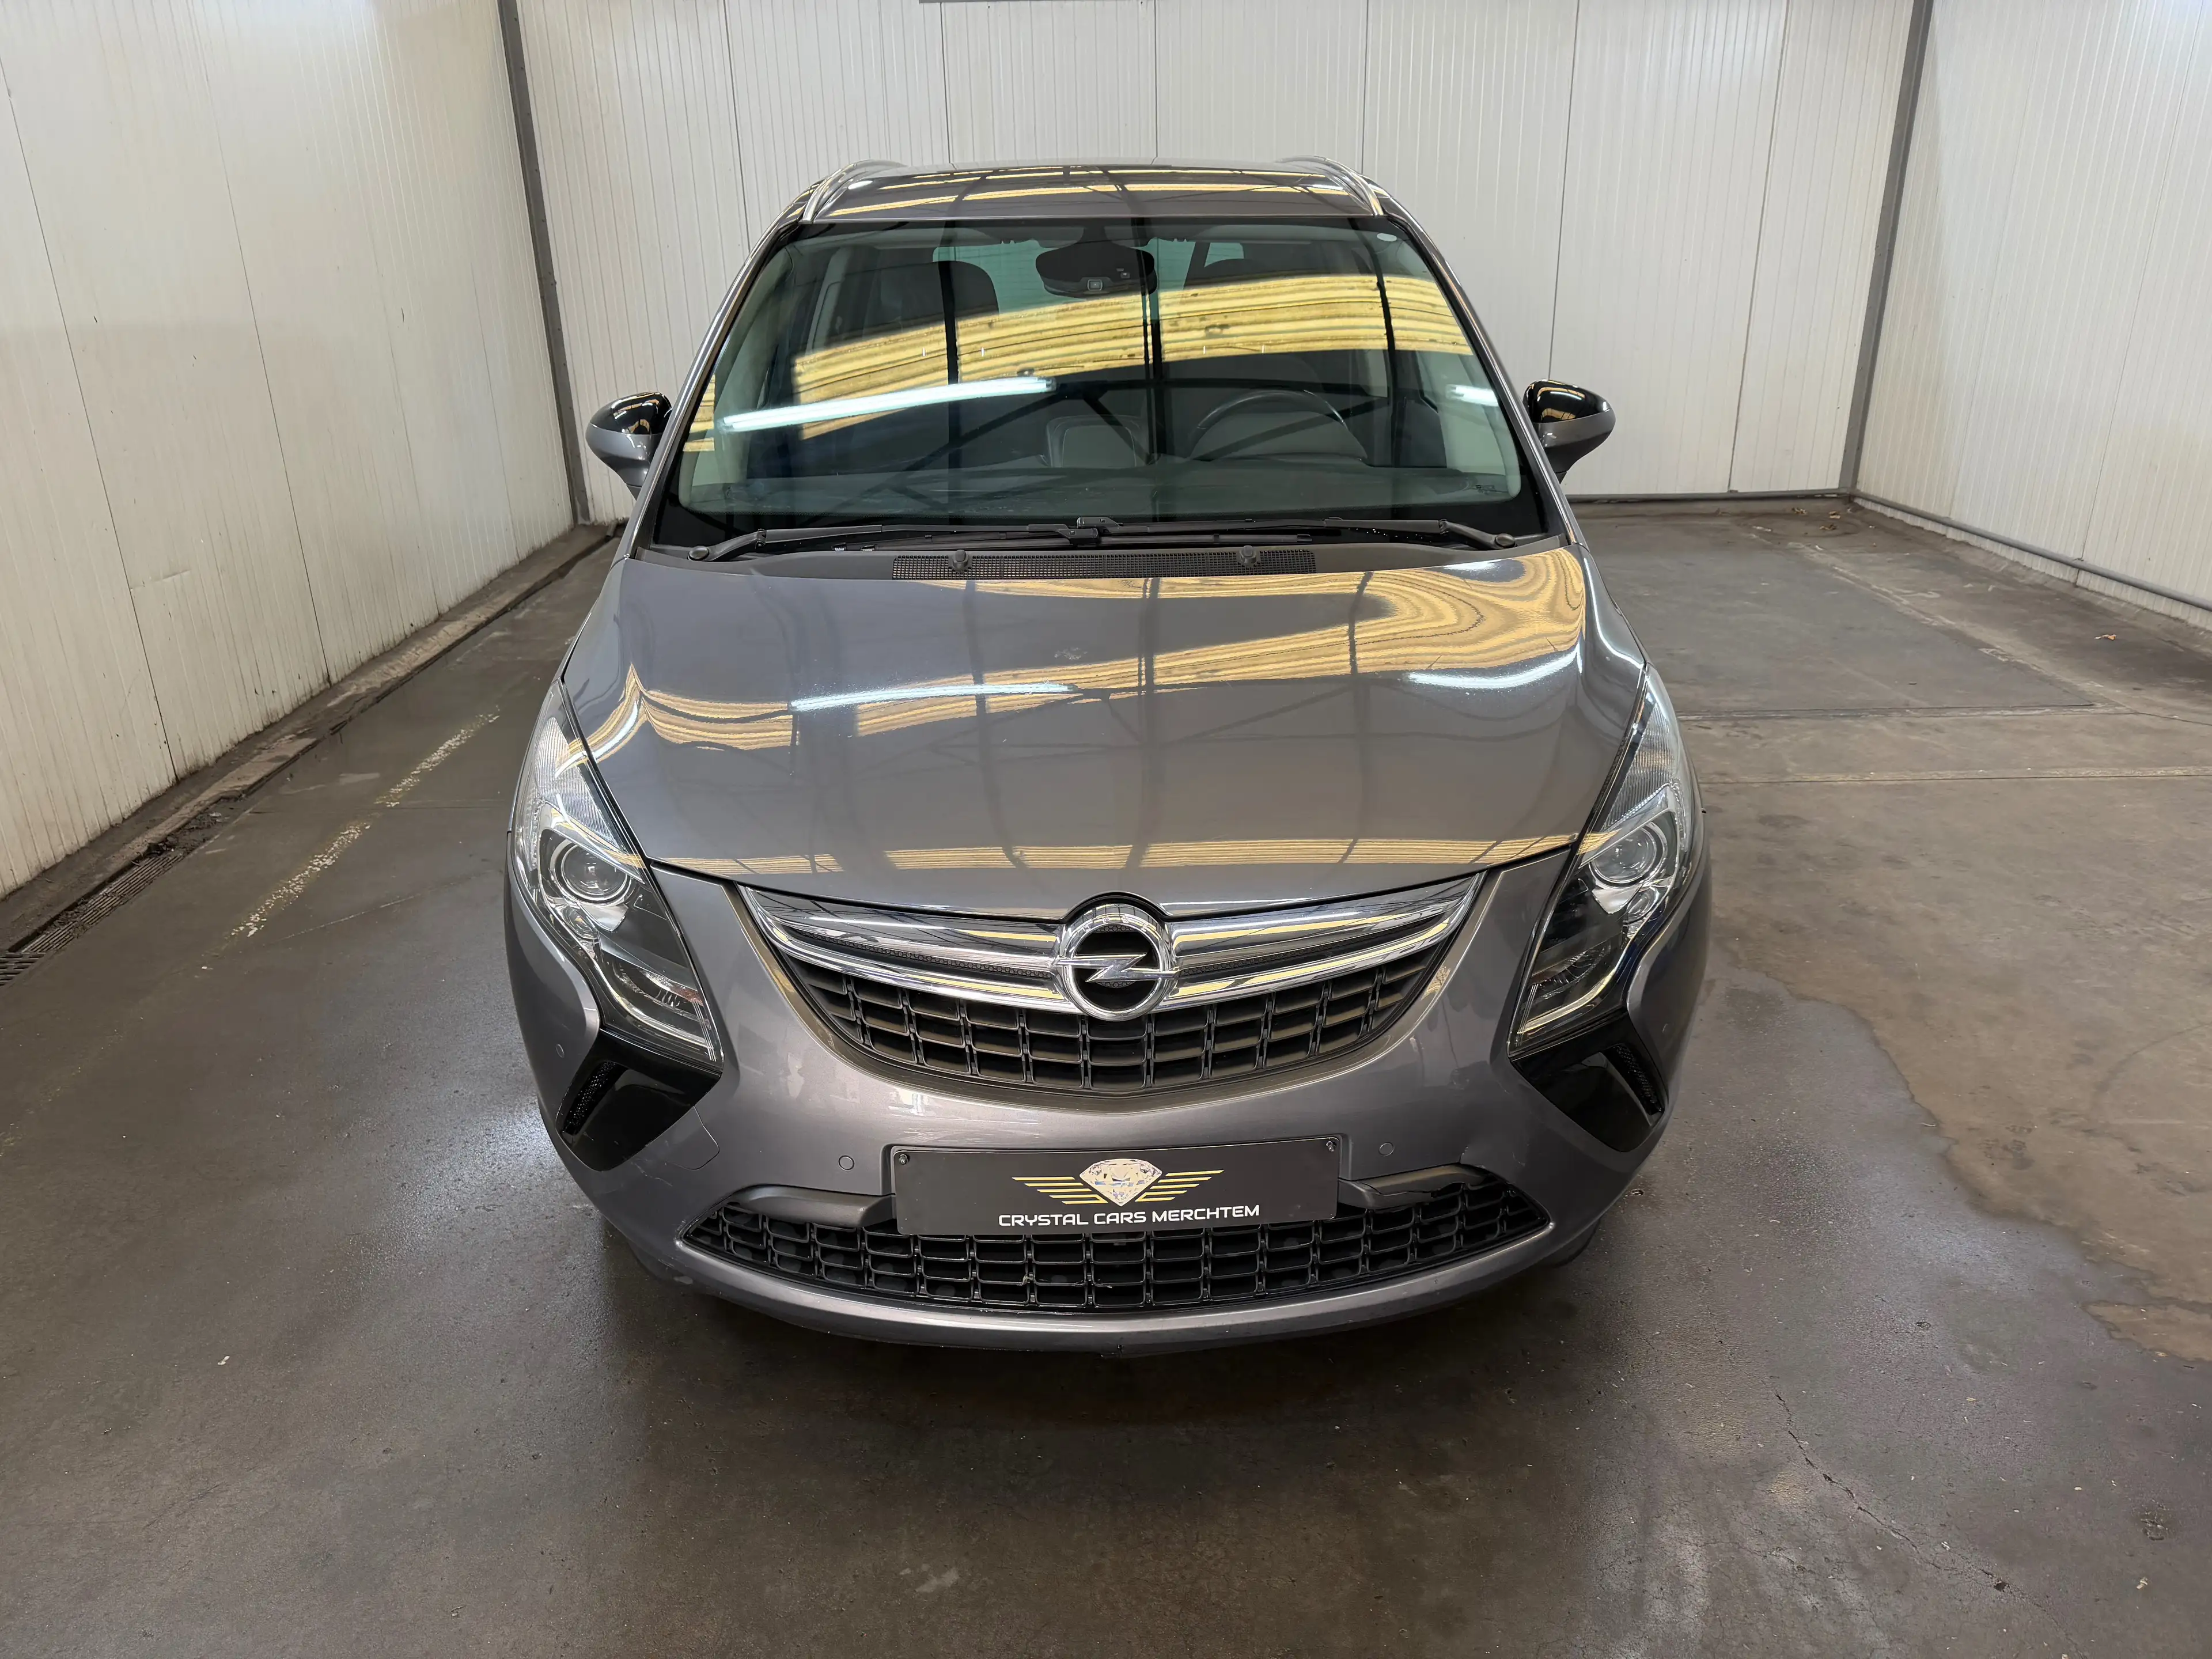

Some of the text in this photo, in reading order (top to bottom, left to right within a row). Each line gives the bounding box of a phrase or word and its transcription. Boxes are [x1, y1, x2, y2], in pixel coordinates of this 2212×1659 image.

[998, 1205, 1260, 1226] CRYSTAL CARS MERCHTEM
